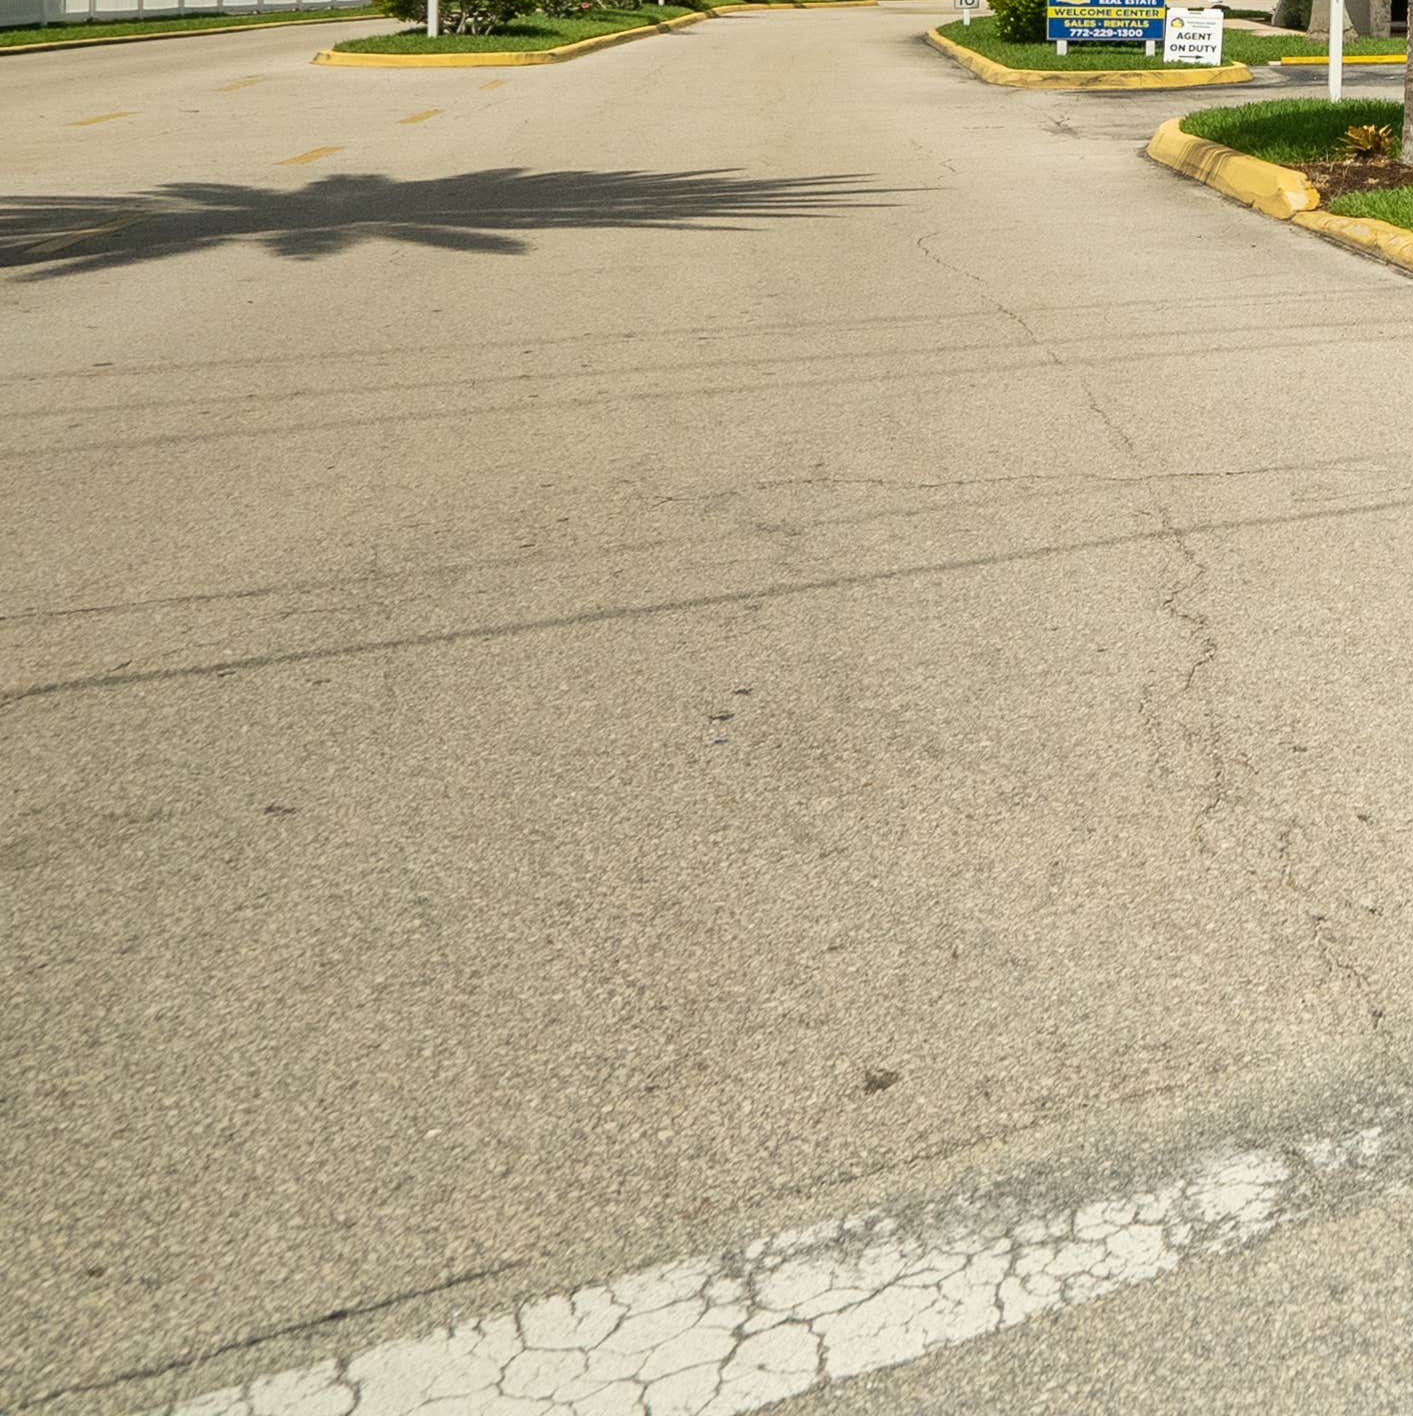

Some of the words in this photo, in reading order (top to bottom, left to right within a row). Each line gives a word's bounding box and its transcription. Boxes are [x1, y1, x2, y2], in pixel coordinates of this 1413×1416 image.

[1115, 9, 1159, 17] CENTER
[1063, 20, 1096, 28] SALES
[1103, 20, 1149, 28] RENTALS
[1177, 32, 1212, 40] AGENT
[1170, 44, 1186, 52] ON
[1189, 44, 1217, 53] DUTY
